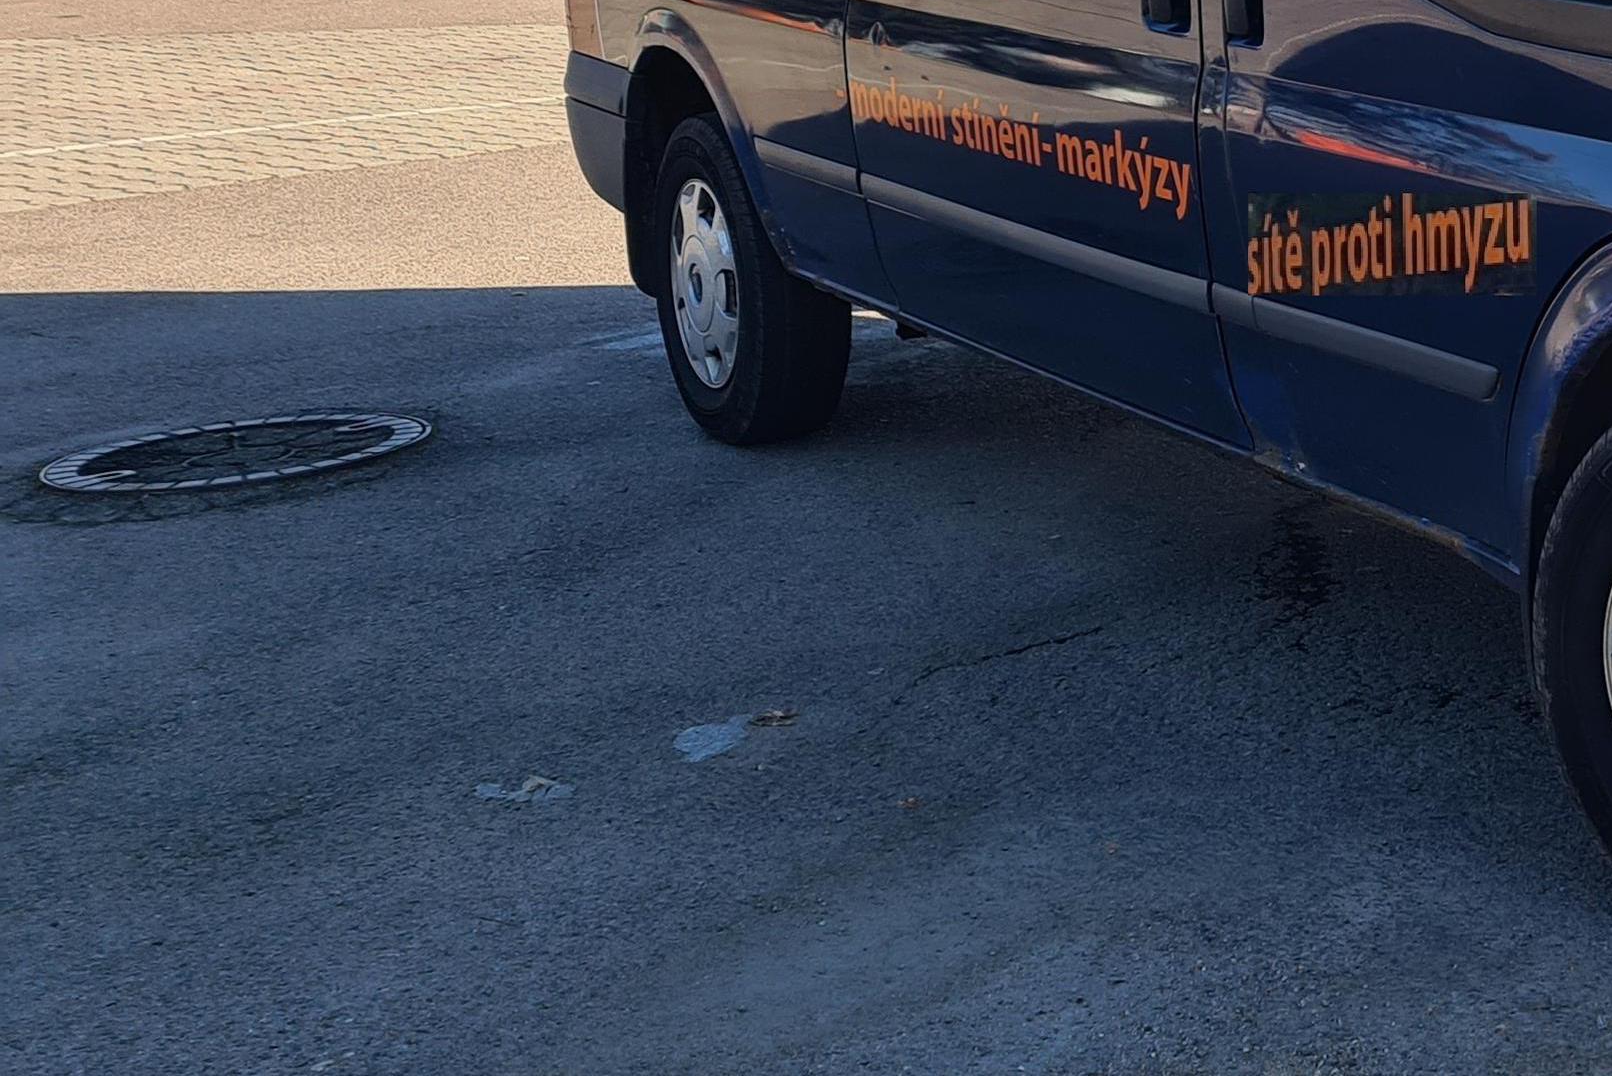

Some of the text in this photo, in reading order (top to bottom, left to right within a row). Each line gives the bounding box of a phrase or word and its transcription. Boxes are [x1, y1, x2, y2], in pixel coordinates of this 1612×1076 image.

[850, 76, 948, 142] moderní
[1055, 129, 1191, 221] markýzy
[1248, 192, 1530, 297] sítě proti hmyzu
